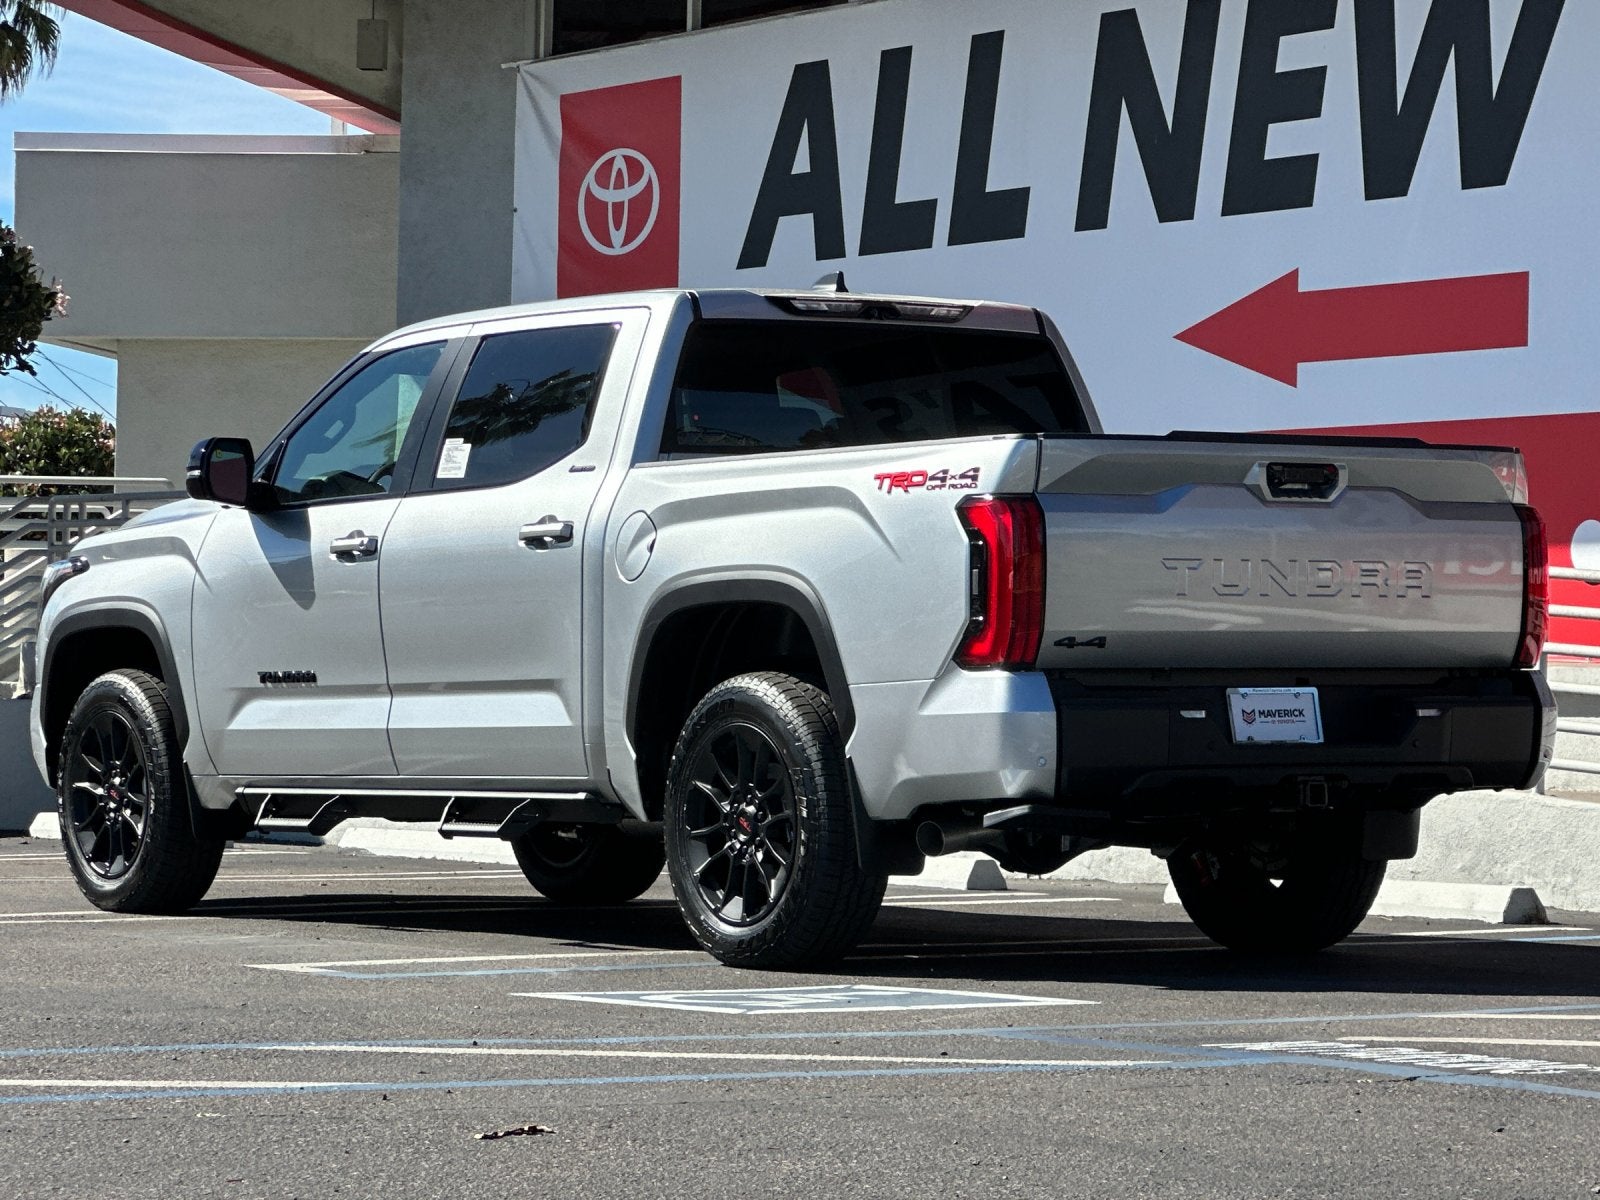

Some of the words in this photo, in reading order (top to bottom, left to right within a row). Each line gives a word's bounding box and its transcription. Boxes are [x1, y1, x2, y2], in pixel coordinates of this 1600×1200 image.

[736, 29, 1031, 270] ALL
[1074, 0, 1566, 231] NEW
[873, 469, 928, 494] TRD
[926, 483, 947, 491] OFF
[948, 482, 978, 490] ROAD
[1160, 557, 1432, 599] TUNDRA
[1258, 708, 1305, 719] MAVERICK
